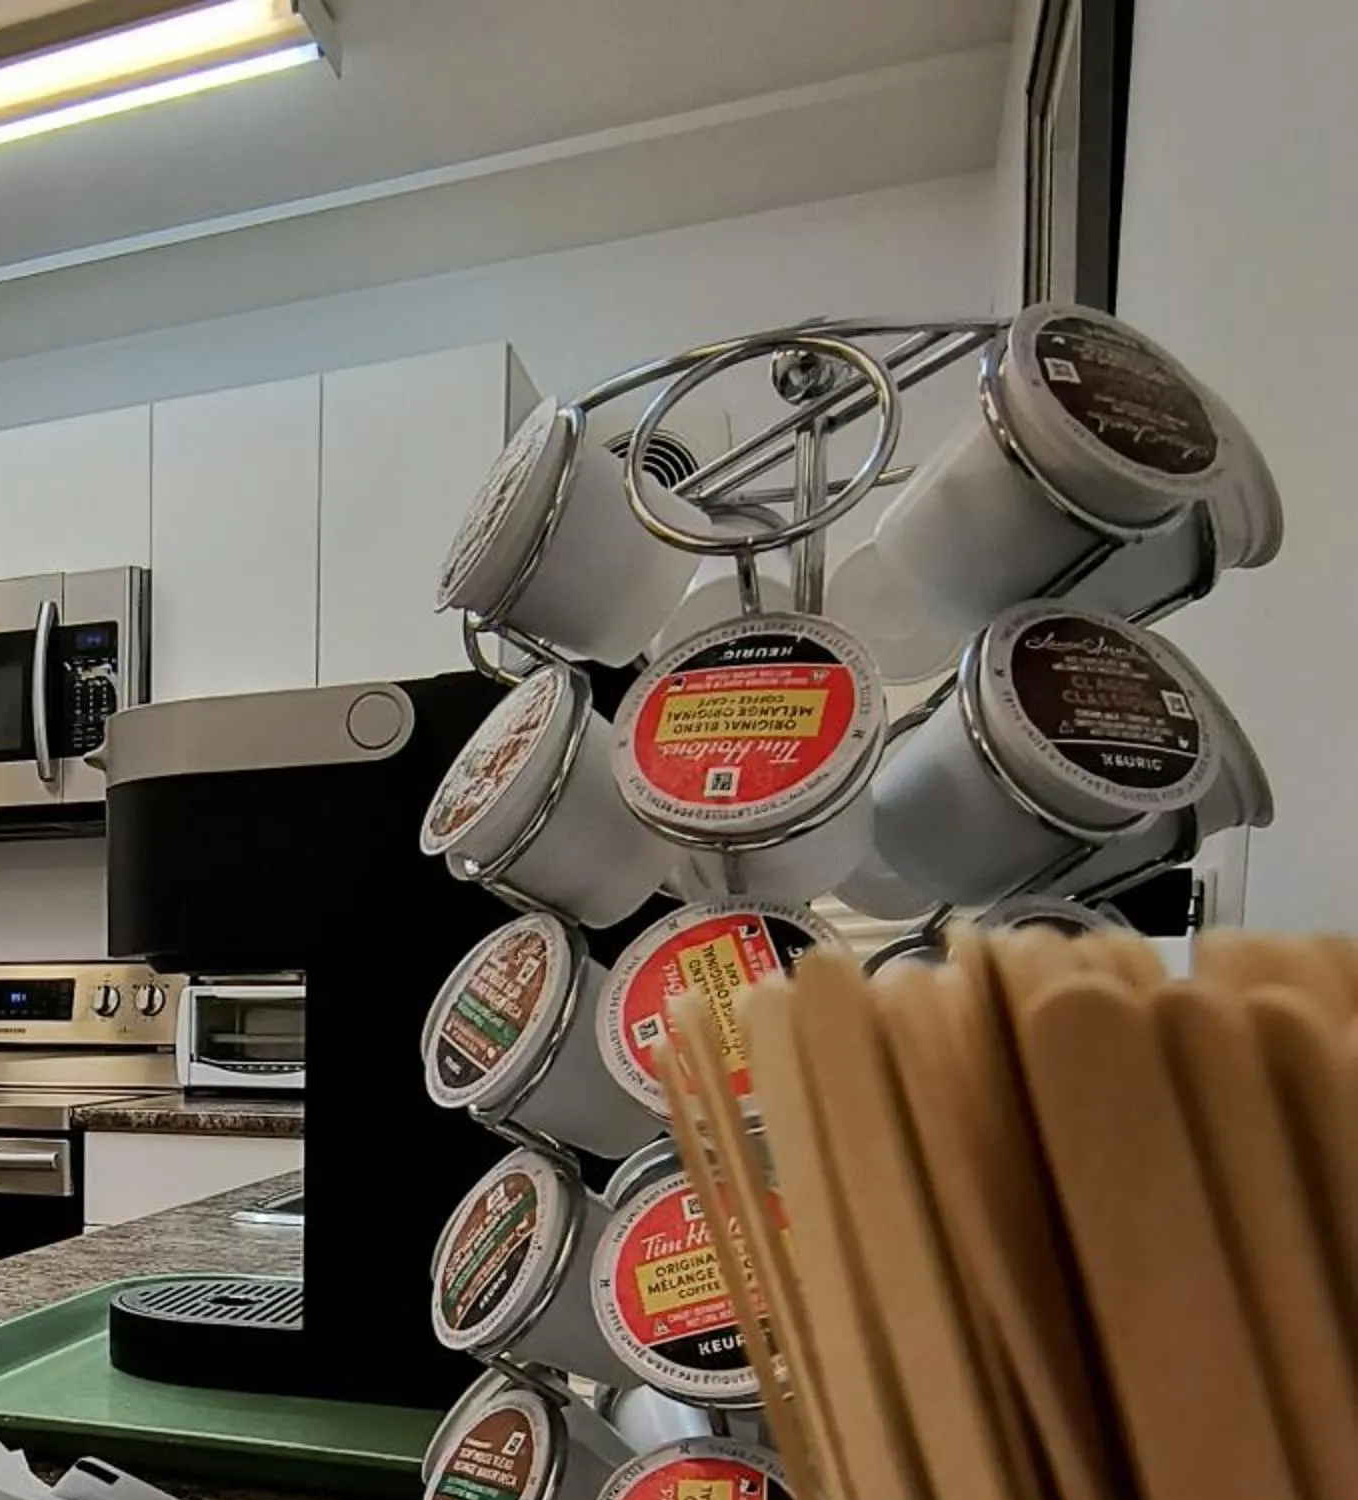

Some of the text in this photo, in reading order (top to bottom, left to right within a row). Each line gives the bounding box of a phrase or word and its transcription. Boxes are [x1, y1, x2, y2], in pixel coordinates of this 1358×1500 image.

[719, 645, 794, 661] KEURIG
[738, 694, 785, 704] COFFEE
[666, 704, 815, 723] MÉLANGE ORIGINAL
[672, 718, 798, 735] ORIGINAL BLEND
[657, 740, 802, 766] Tim Hortons
[1101, 752, 1164, 772] KEURIG
[642, 1232, 682, 1260] Tim
[654, 1251, 718, 1277] ORIGINA
[647, 1267, 716, 1296] MÉLANGE
[677, 1281, 721, 1299] COFFEE
[697, 1333, 746, 1355] KEUR
